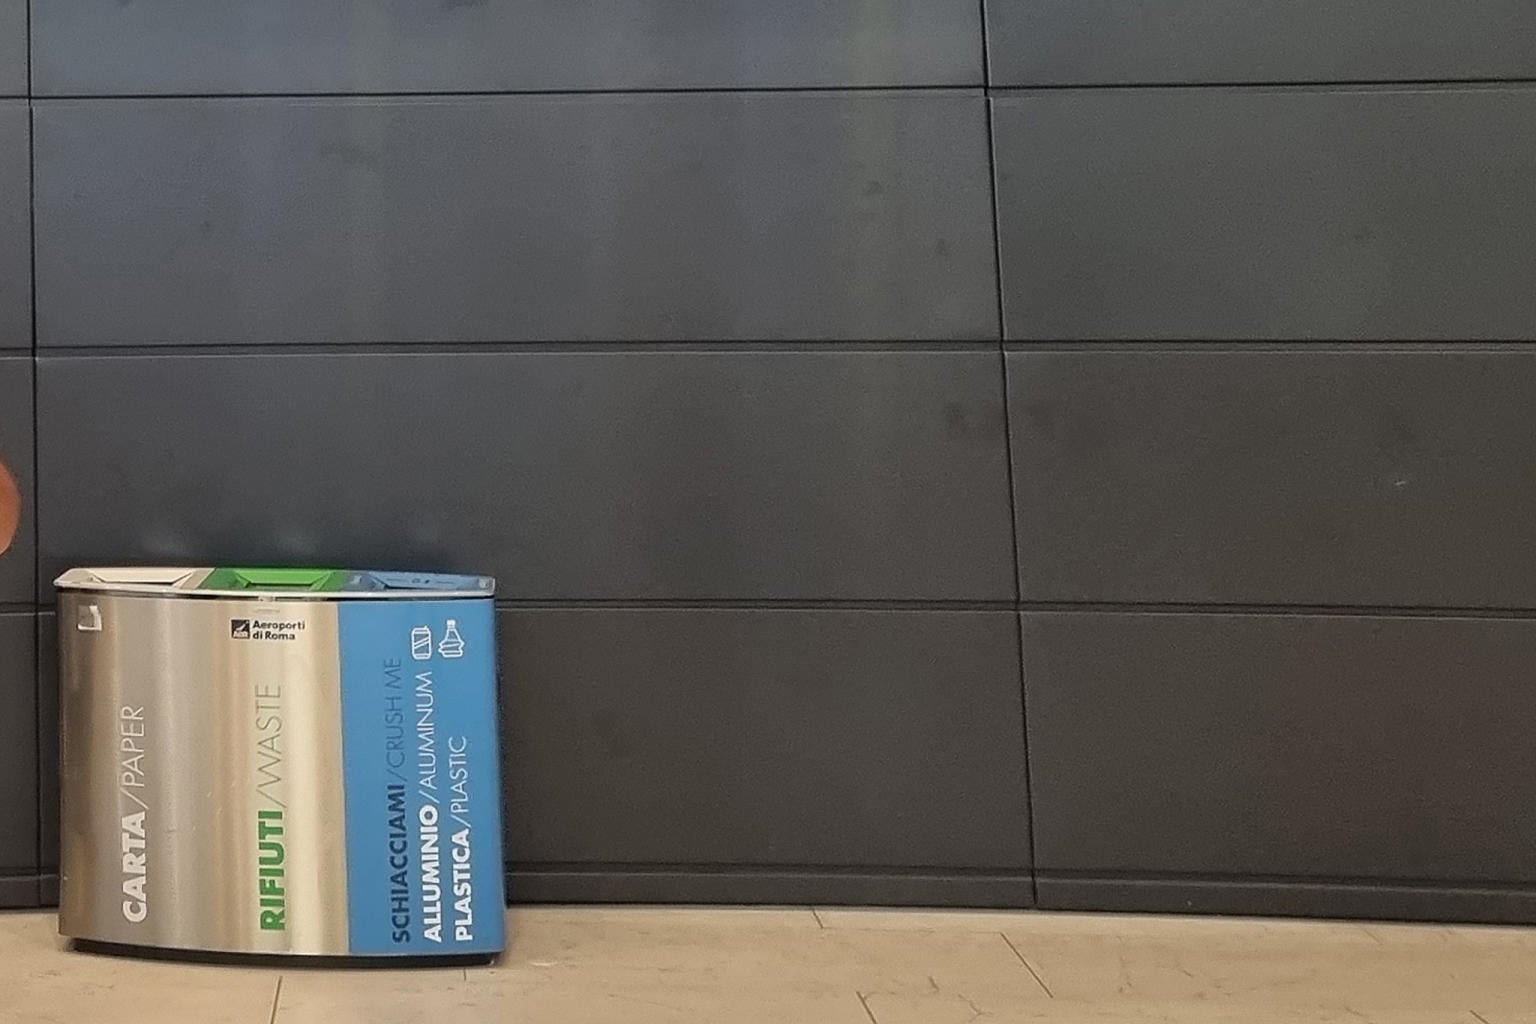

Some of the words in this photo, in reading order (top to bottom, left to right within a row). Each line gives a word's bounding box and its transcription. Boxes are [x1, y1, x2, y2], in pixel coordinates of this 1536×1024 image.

[252, 631, 263, 640] di
[265, 631, 296, 640] Roma
[253, 620, 305, 631] Aeroporti
[384, 658, 402, 689] ME
[119, 705, 147, 923] CARTA/PAPER
[255, 684, 285, 931] RIFIUTI/WASTE
[384, 697, 410, 944] SCHIACCIAMI/CRUSH
[413, 671, 442, 943] ALLUMINIO/ALUMINUM
[448, 735, 473, 941] PLASTICA/PLASTIC
